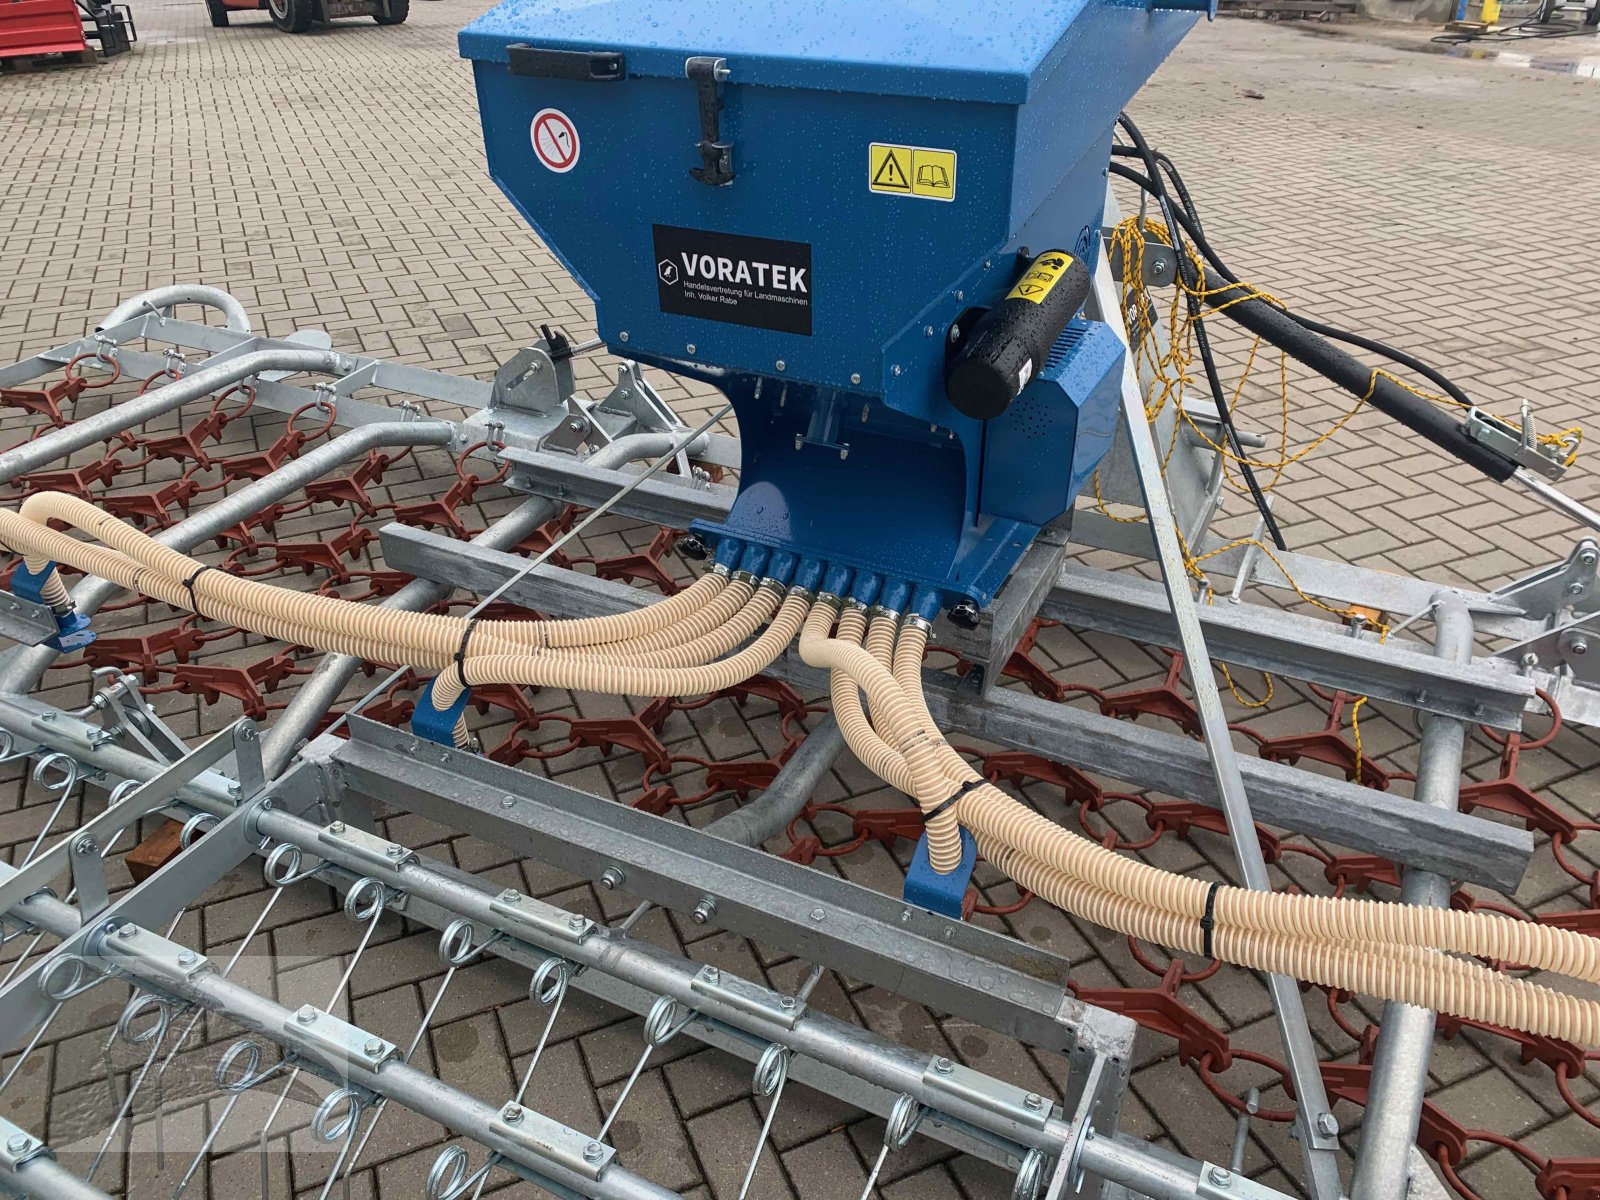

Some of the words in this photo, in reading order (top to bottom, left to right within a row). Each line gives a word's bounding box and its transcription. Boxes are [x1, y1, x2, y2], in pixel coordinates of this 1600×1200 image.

[681, 252, 808, 293] VORATEK
[683, 280, 742, 298] Handelsvertretung
[744, 289, 753, 298] für
[754, 293, 808, 306] Landmaschinen
[684, 290, 697, 299] Inh.
[698, 292, 718, 302] Volker
[719, 296, 738, 305] Rabe
